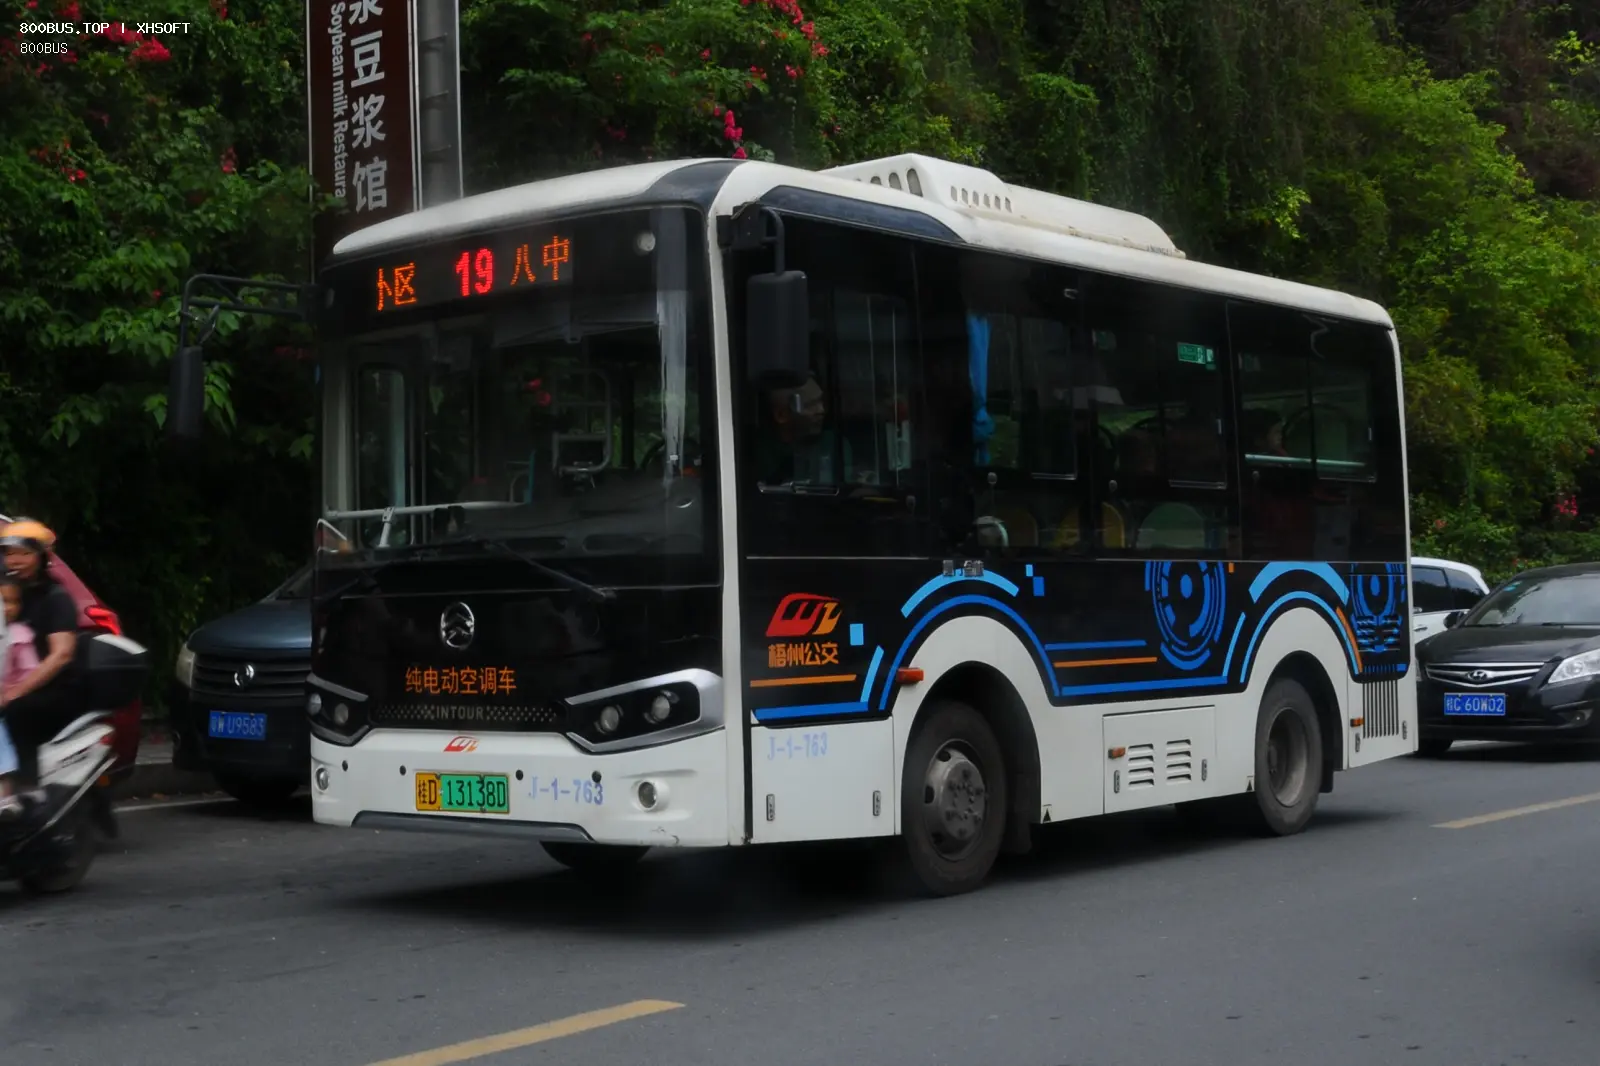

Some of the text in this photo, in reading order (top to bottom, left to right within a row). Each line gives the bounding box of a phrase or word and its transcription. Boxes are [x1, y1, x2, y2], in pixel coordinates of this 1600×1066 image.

[328, 2, 349, 198] Soybean milk Restaura
[455, 247, 494, 297] 19
[510, 235, 571, 286] 八中
[767, 641, 840, 669] 梧州公交
[405, 665, 517, 696] 纯电动空调车
[767, 731, 828, 761] J-1-763
[528, 776, 604, 806] J-1-763
